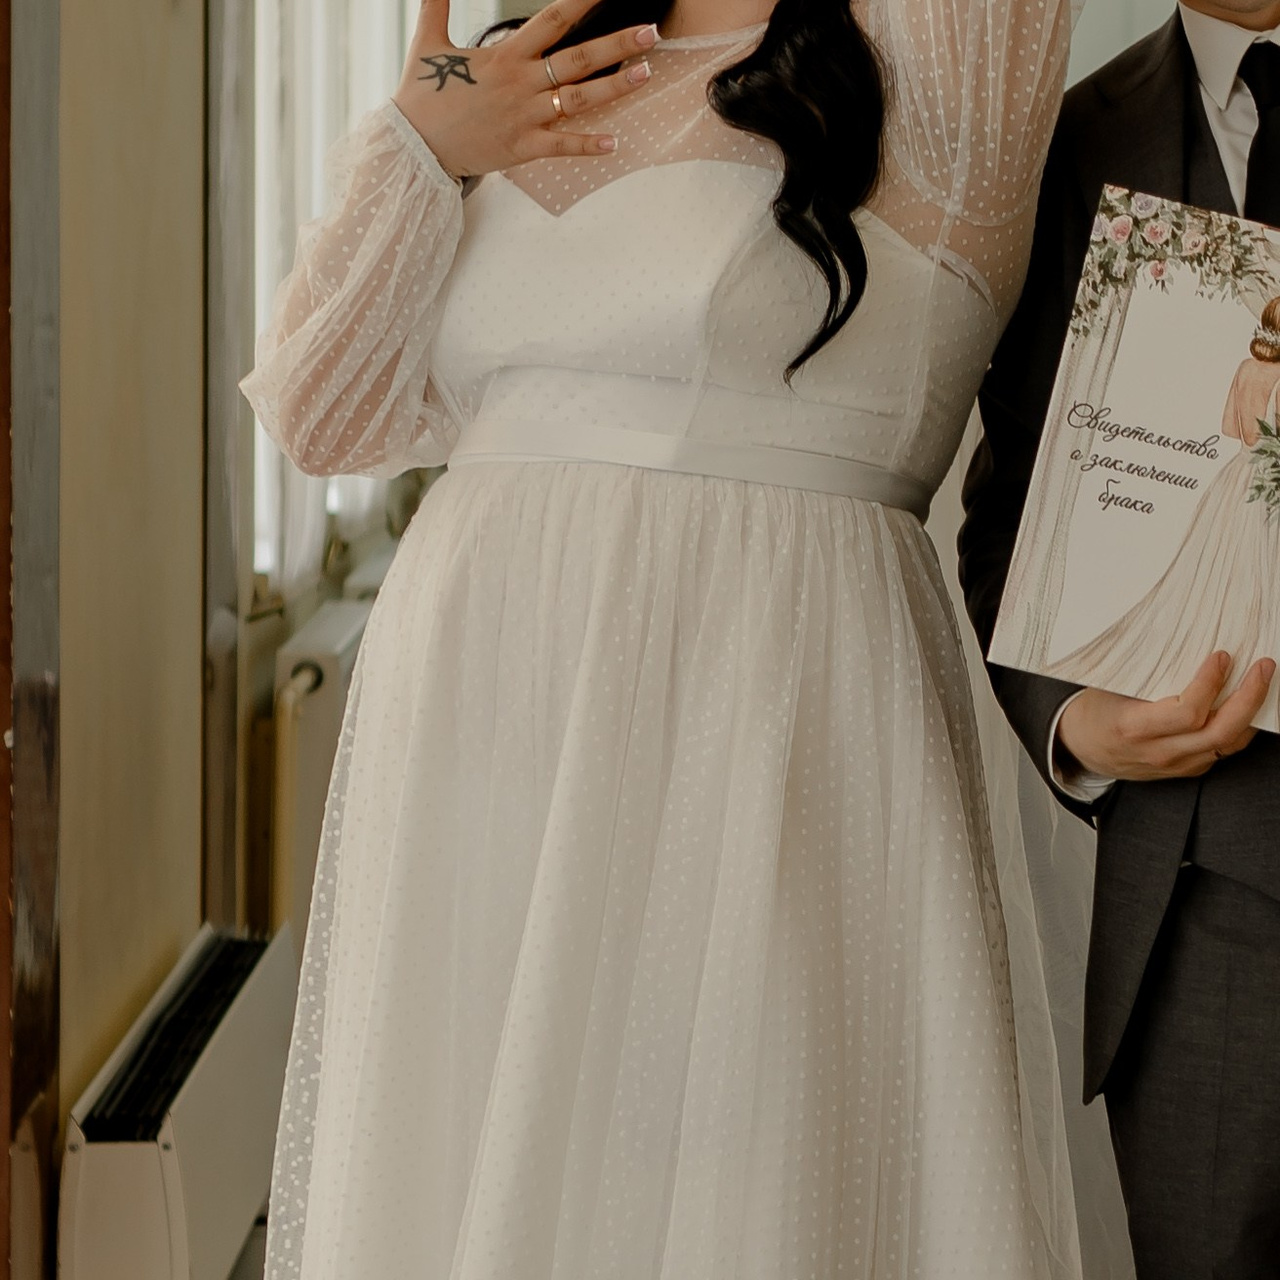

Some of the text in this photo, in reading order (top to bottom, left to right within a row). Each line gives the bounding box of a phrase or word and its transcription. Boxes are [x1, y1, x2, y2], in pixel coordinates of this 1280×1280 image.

[1067, 400, 1219, 460] Свидетельство
[1070, 449, 1199, 490] о заключении
[1098, 479, 1154, 514] брака
